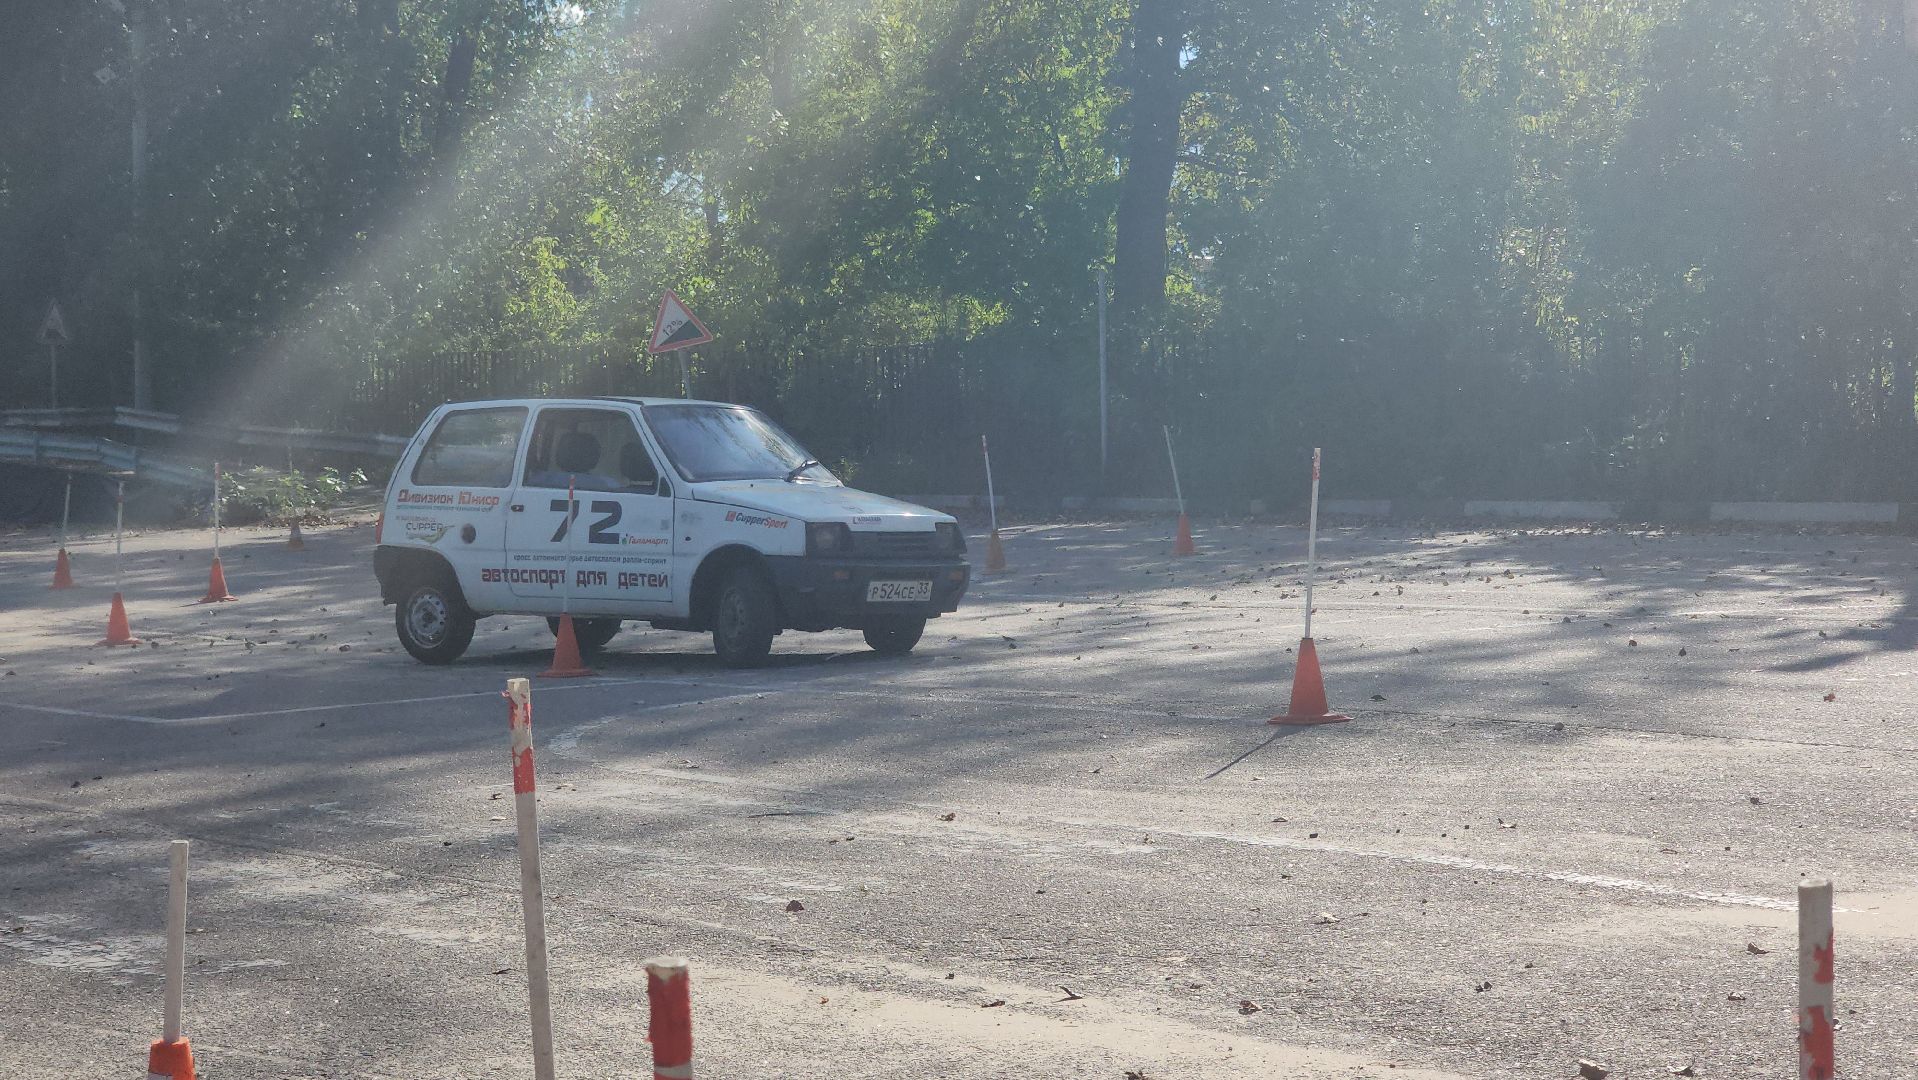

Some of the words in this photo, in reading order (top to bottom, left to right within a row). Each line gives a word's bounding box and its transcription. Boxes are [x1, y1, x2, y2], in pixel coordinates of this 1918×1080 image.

[662, 319, 683, 337] 12%
[397, 489, 454, 504] Дивизион
[458, 491, 500, 506] Юниор
[549, 499, 623, 545] 72
[735, 512, 788, 529] CupperSport
